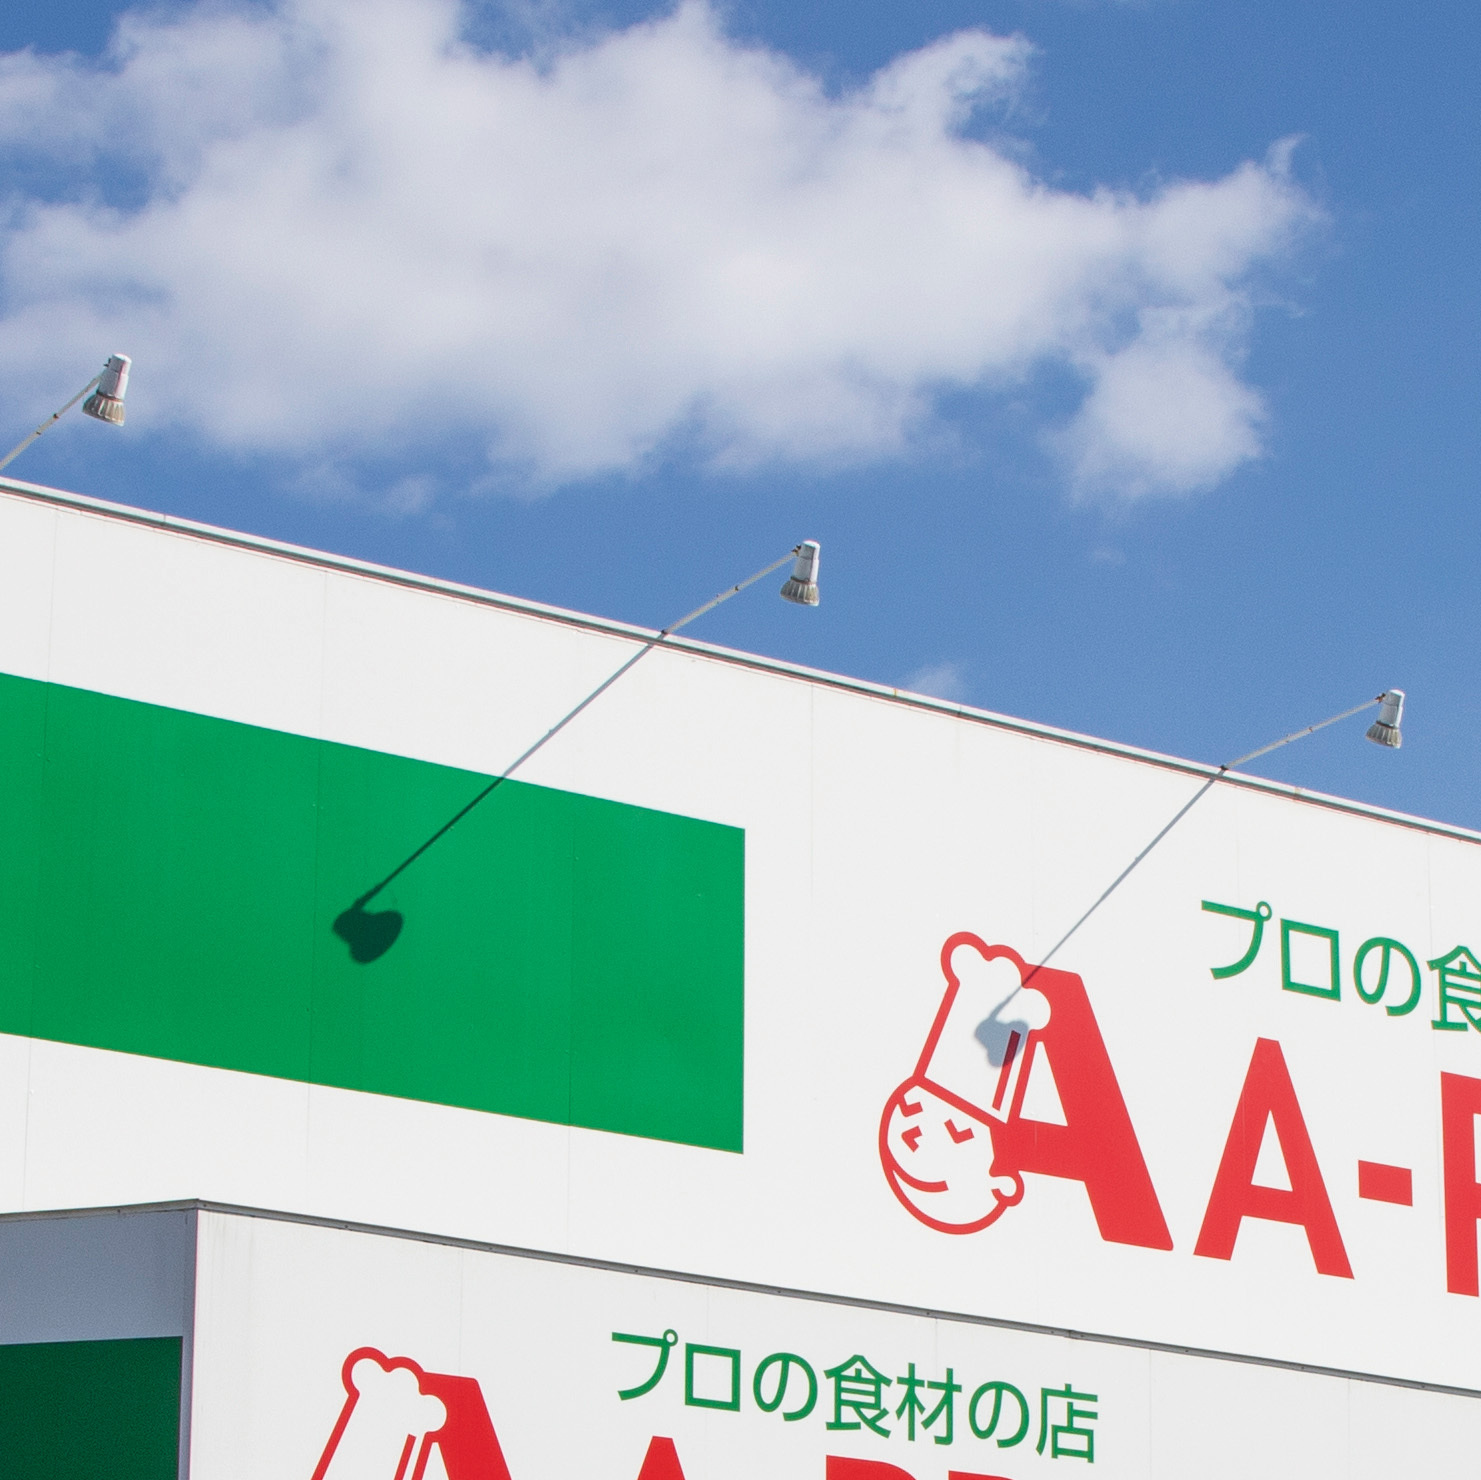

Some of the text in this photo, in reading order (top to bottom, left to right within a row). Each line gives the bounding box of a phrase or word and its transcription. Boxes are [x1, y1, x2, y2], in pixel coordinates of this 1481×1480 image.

[611, 1327, 1099, 1464] プロの食材の店
